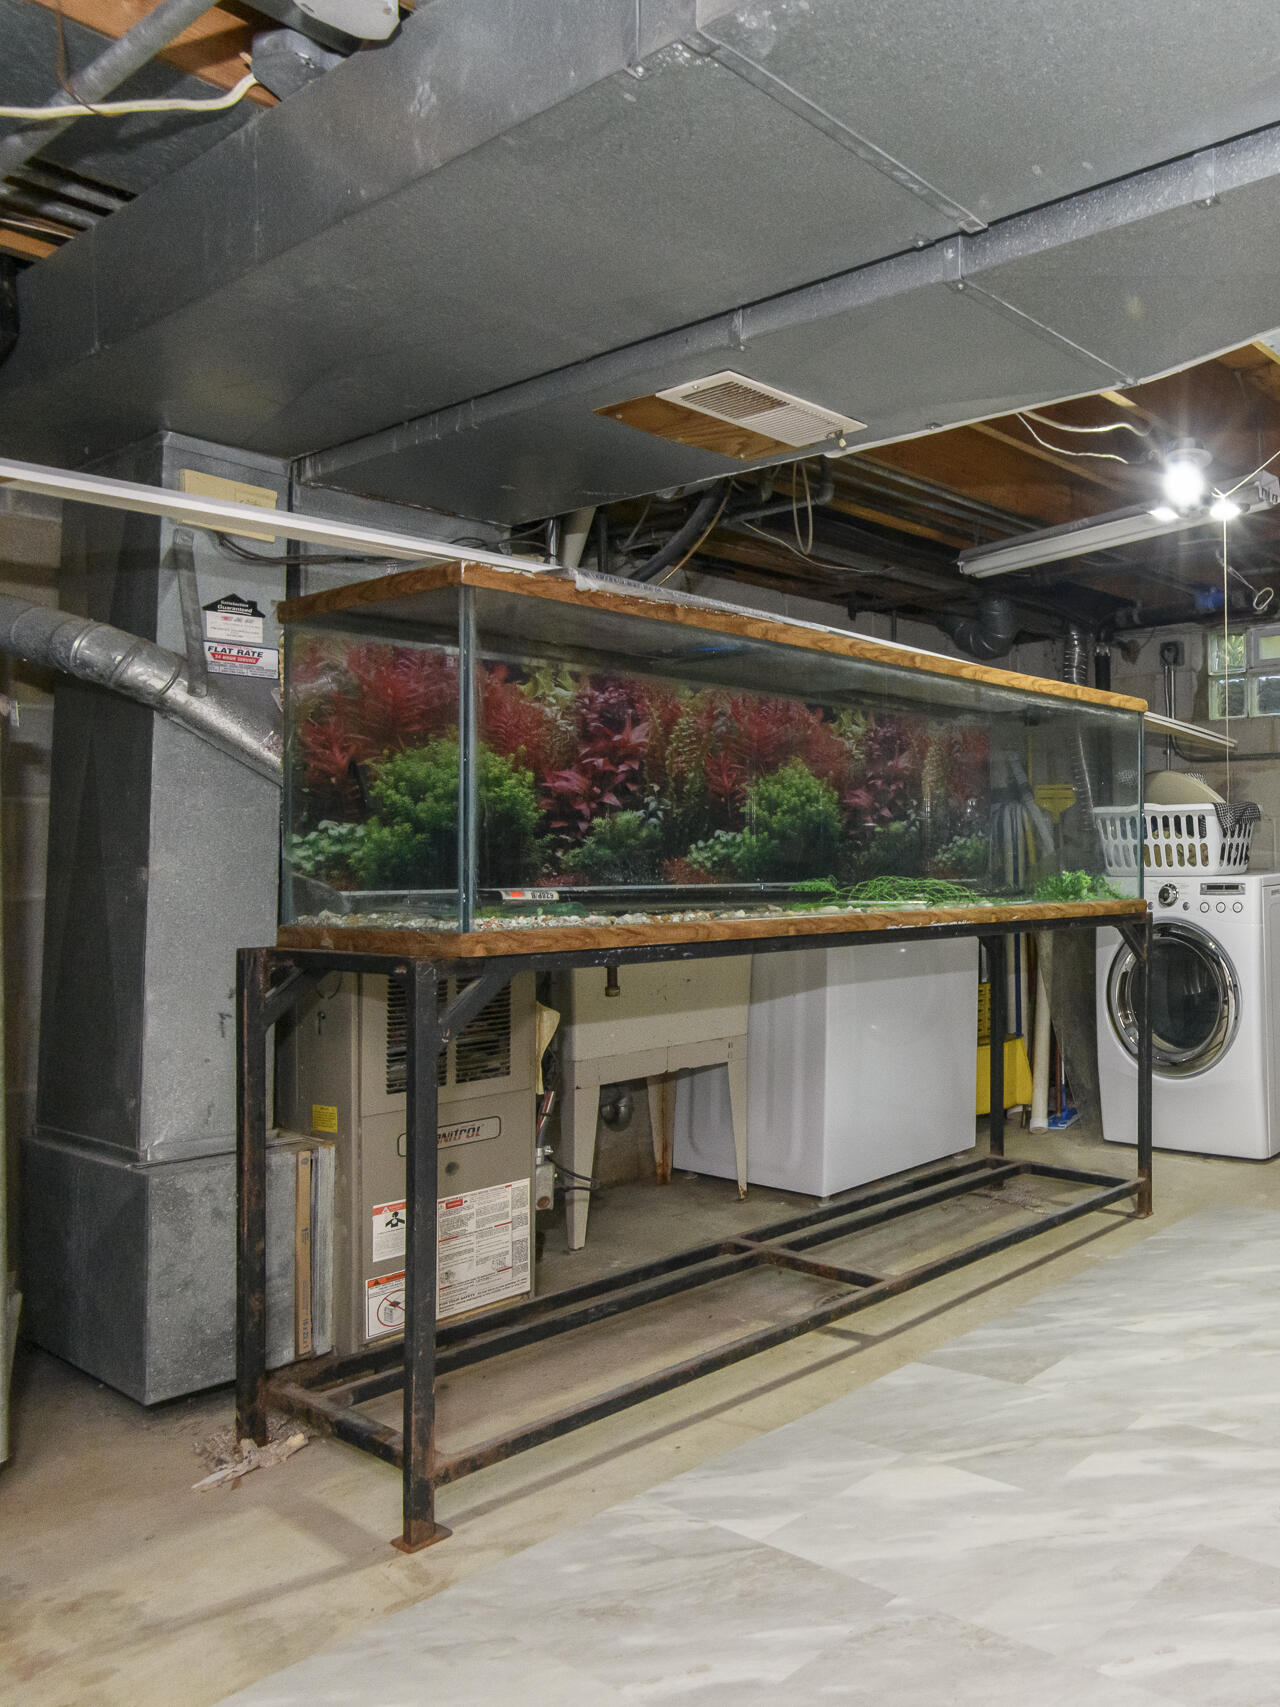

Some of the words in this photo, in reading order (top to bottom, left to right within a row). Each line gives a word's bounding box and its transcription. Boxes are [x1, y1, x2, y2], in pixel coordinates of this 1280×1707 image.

[217, 604, 253, 613] Guaranteed
[208, 646, 234, 654] FLAT
[237, 650, 263, 658] RATE
